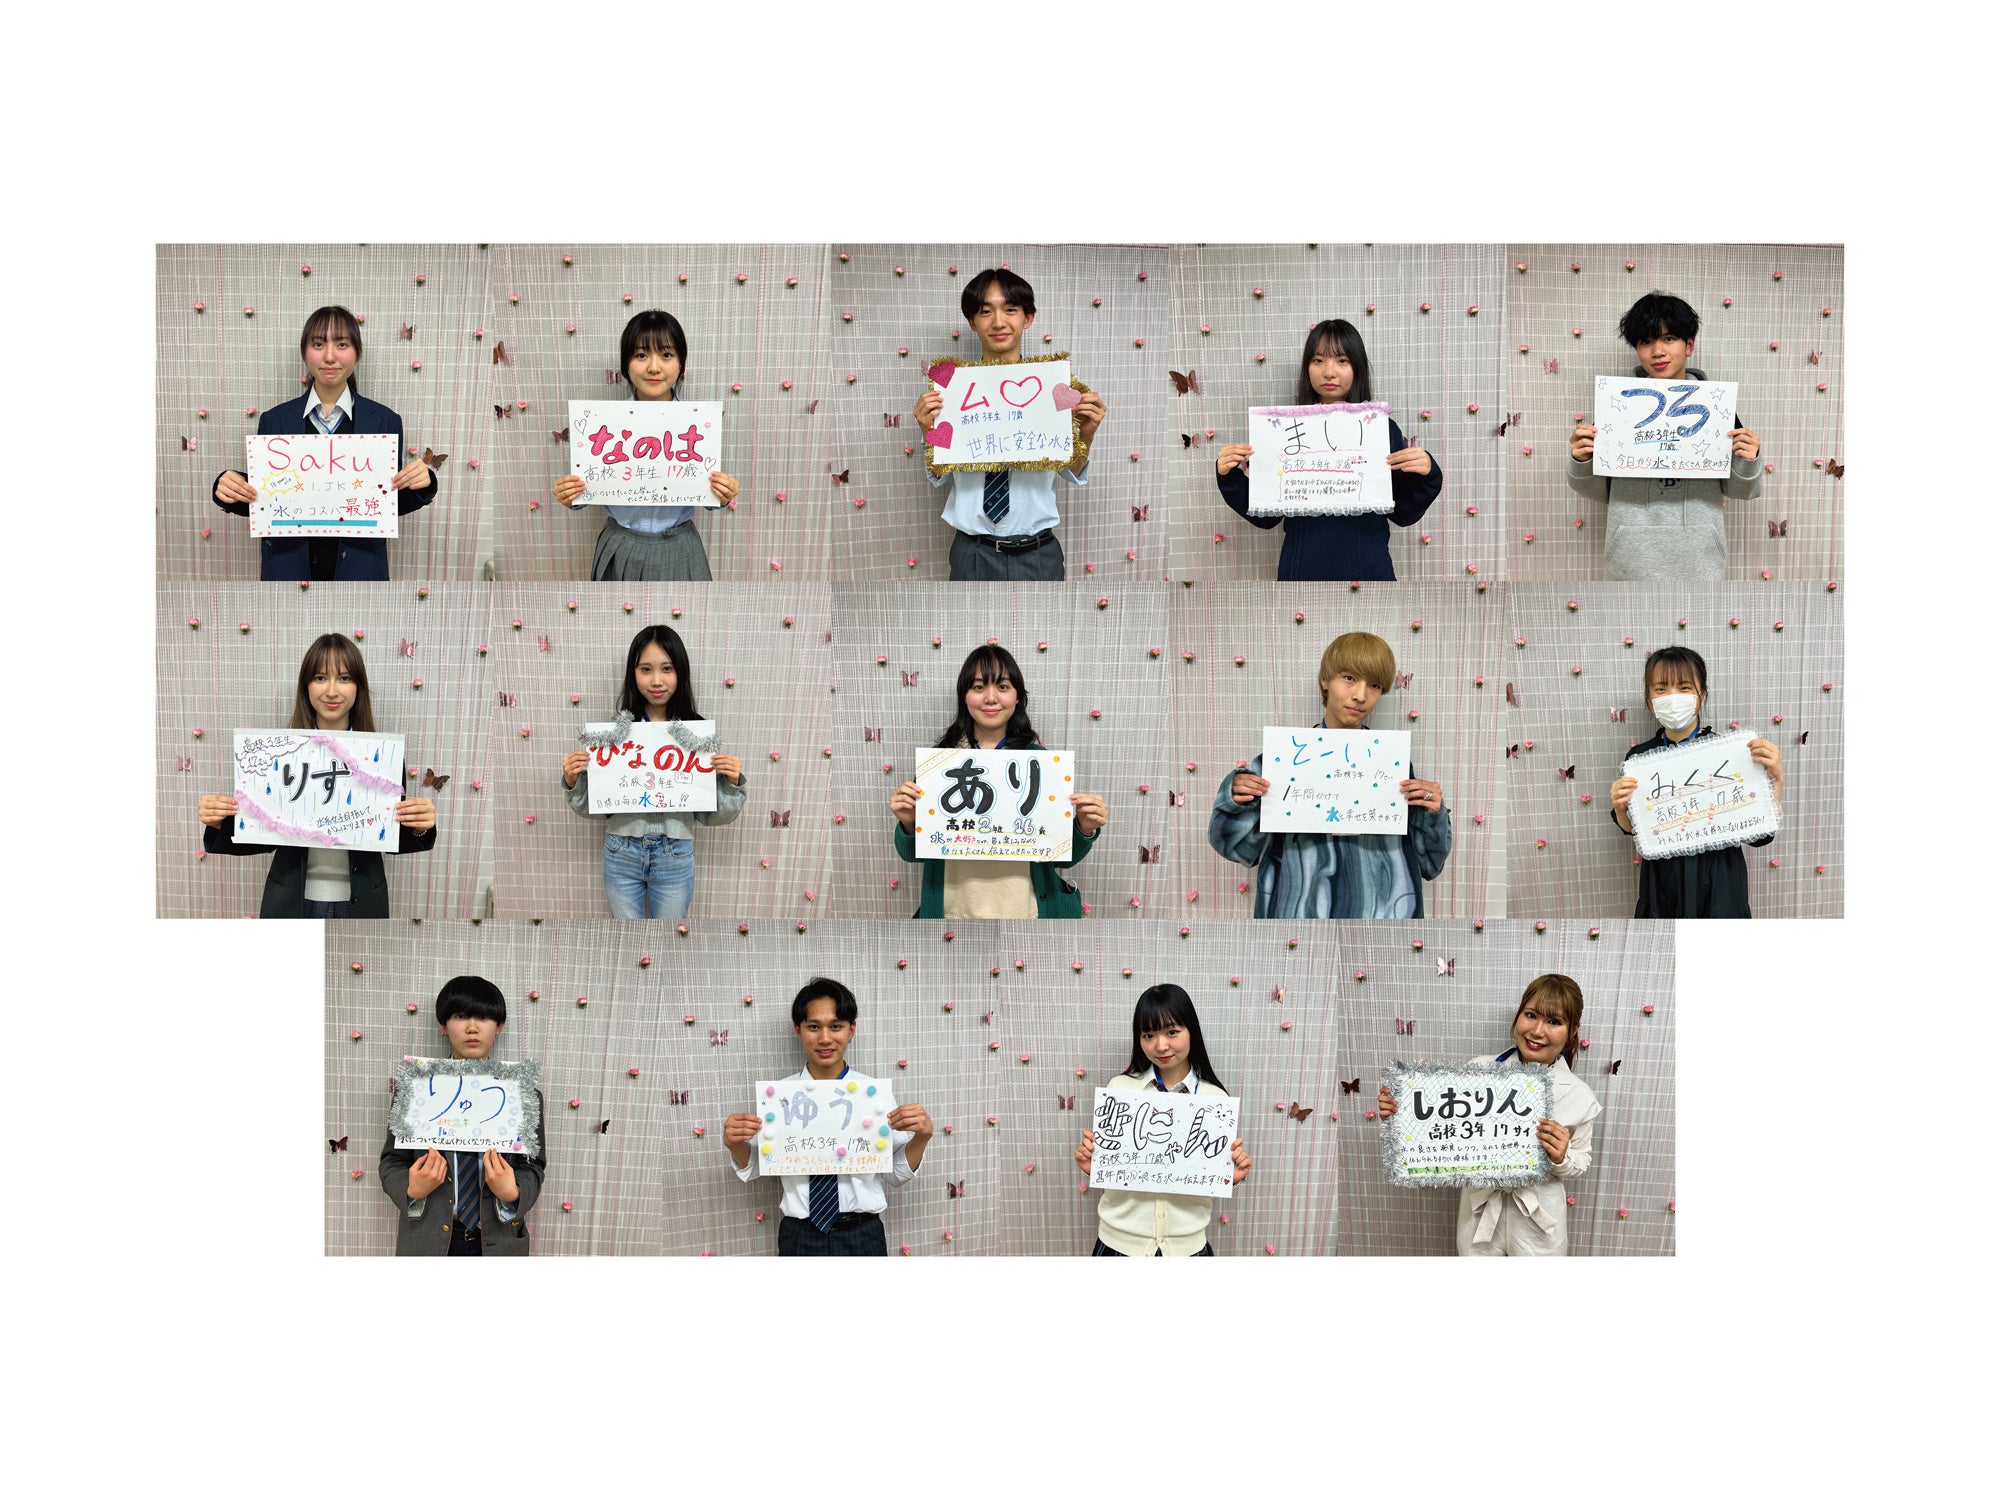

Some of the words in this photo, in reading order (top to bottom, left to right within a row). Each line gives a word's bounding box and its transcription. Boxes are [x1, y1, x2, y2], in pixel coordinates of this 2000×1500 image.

[960, 411, 1002, 427] 高校3年生
[1008, 410, 1024, 421] 17歳
[1620, 384, 1711, 438] つる
[588, 424, 704, 465] なのは
[966, 429, 1071, 460] 世界に安全な水を
[1283, 418, 1364, 455] まい
[1634, 429, 1677, 443] 高校3年生
[1659, 442, 1676, 451] 17歳
[267, 437, 374, 474] Saku
[1616, 454, 1730, 470] 今日から水をたくさん飲みます
[589, 740, 716, 773] ひなのん
[940, 757, 1041, 817] あり
[1333, 769, 1365, 779] 高校3年
[1282, 785, 1340, 802] 1年間かけて
[1655, 797, 1700, 825] 高校3年
[779, 1087, 853, 1131] ゆう
[1413, 1087, 1533, 1121] しおりん
[784, 1136, 838, 1153] 高校3年
[847, 1137, 872, 1153] 17歳
[1094, 1096, 1228, 1164] きにゃん
[1428, 1121, 1486, 1140] 高校3年
[1099, 1152, 1141, 1166] 高校3年
[1144, 1153, 1165, 1165] 17歳
